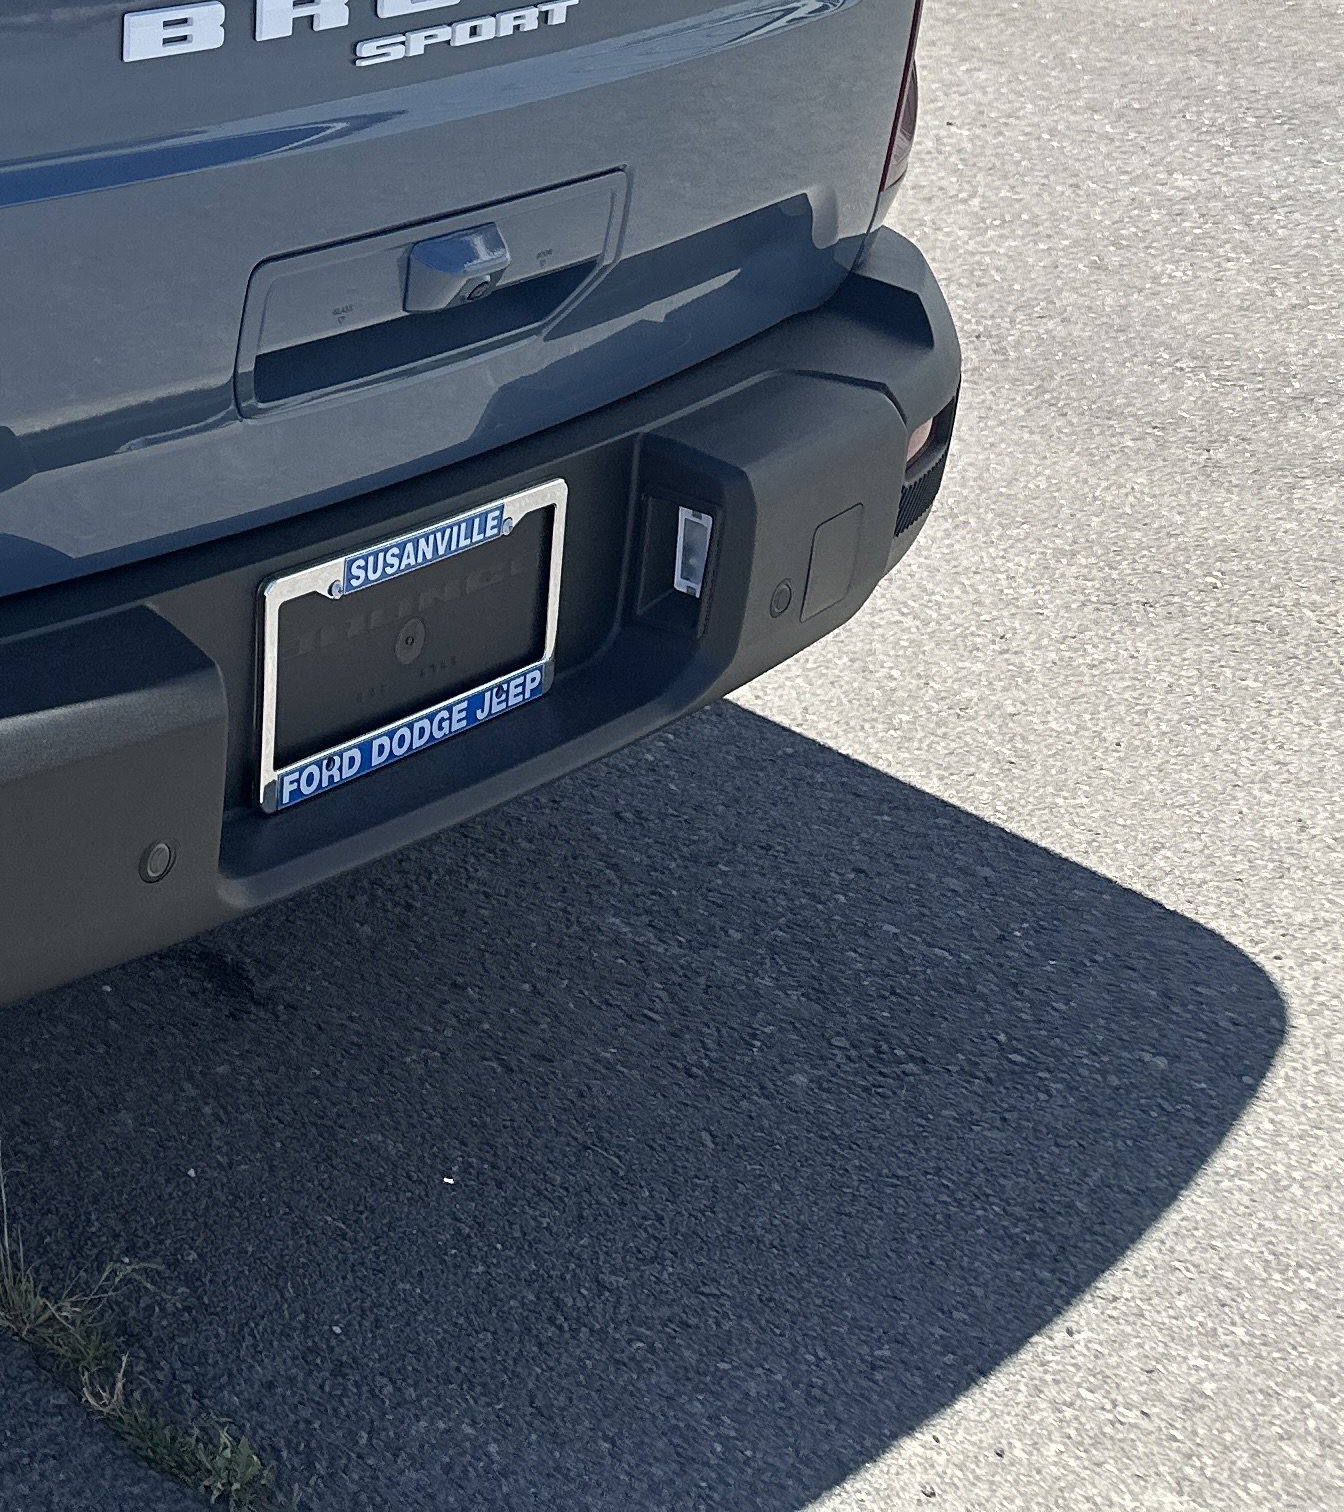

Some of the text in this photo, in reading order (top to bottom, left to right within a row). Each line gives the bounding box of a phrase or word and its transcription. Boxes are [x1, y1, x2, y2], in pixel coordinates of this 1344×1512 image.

[349, 508, 501, 588] SUSANVILLE
[281, 669, 543, 804] FORD DODGE JEEP
